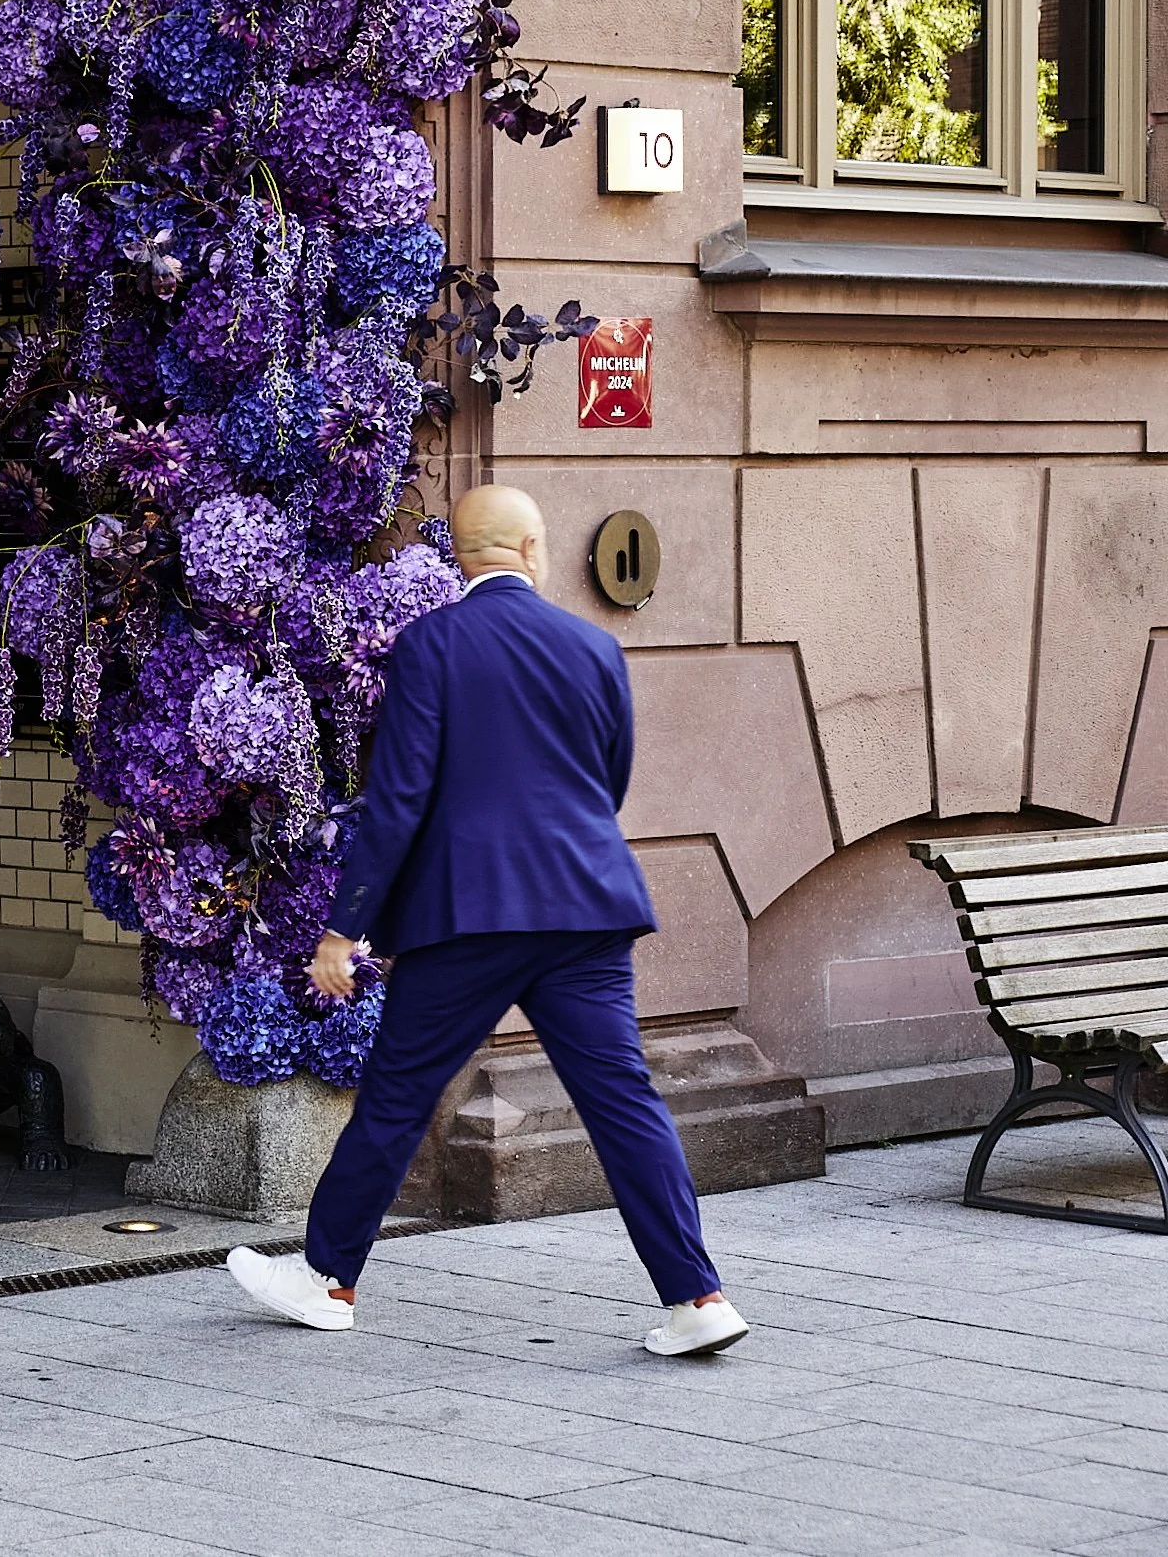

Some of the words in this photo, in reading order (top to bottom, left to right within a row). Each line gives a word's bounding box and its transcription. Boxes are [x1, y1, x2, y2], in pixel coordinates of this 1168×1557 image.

[639, 132, 674, 168] 10
[590, 356, 646, 371] MICHELIN
[607, 375, 633, 390] 2024
